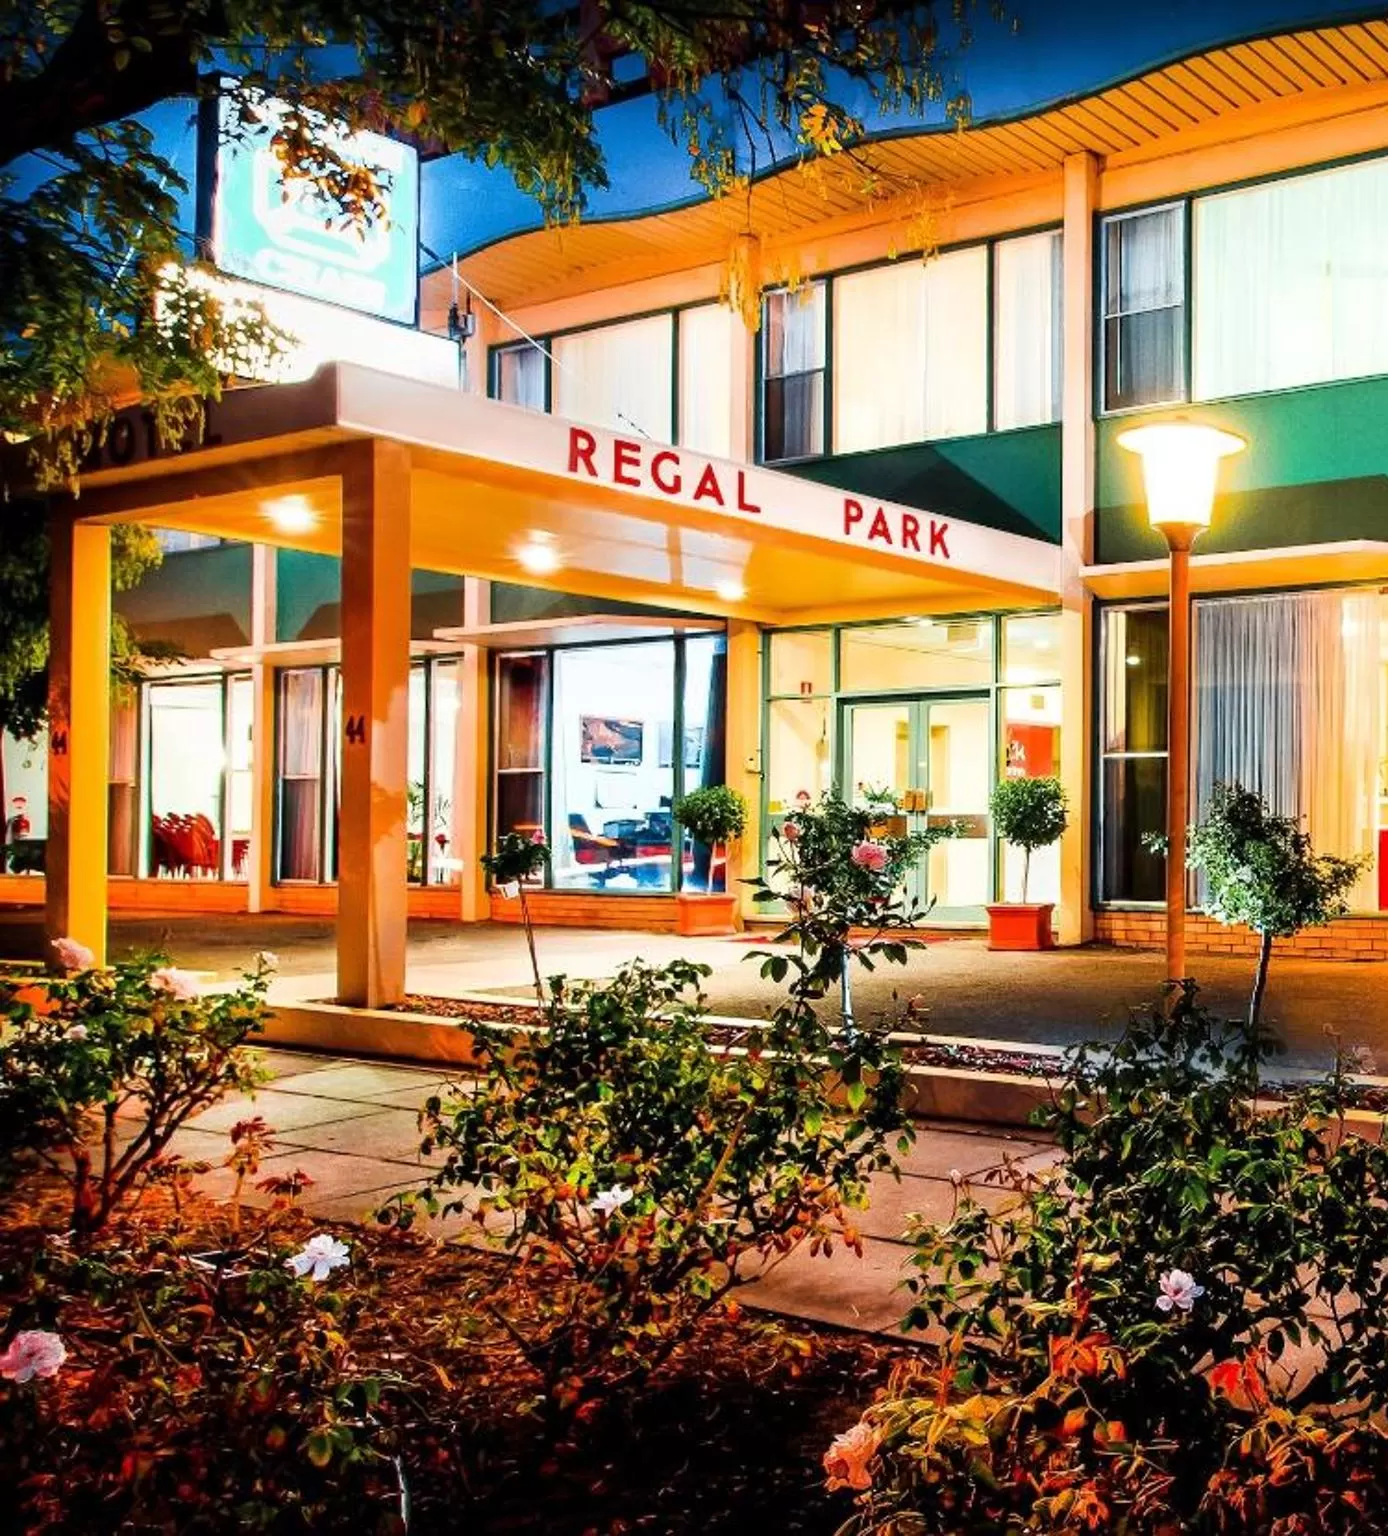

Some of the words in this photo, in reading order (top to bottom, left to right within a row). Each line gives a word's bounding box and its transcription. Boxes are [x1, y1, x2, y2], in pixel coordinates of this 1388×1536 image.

[568, 427, 761, 514] REGAL
[844, 498, 950, 559] PARK
[51, 731, 67, 755] 44
[345, 715, 365, 744] 44
